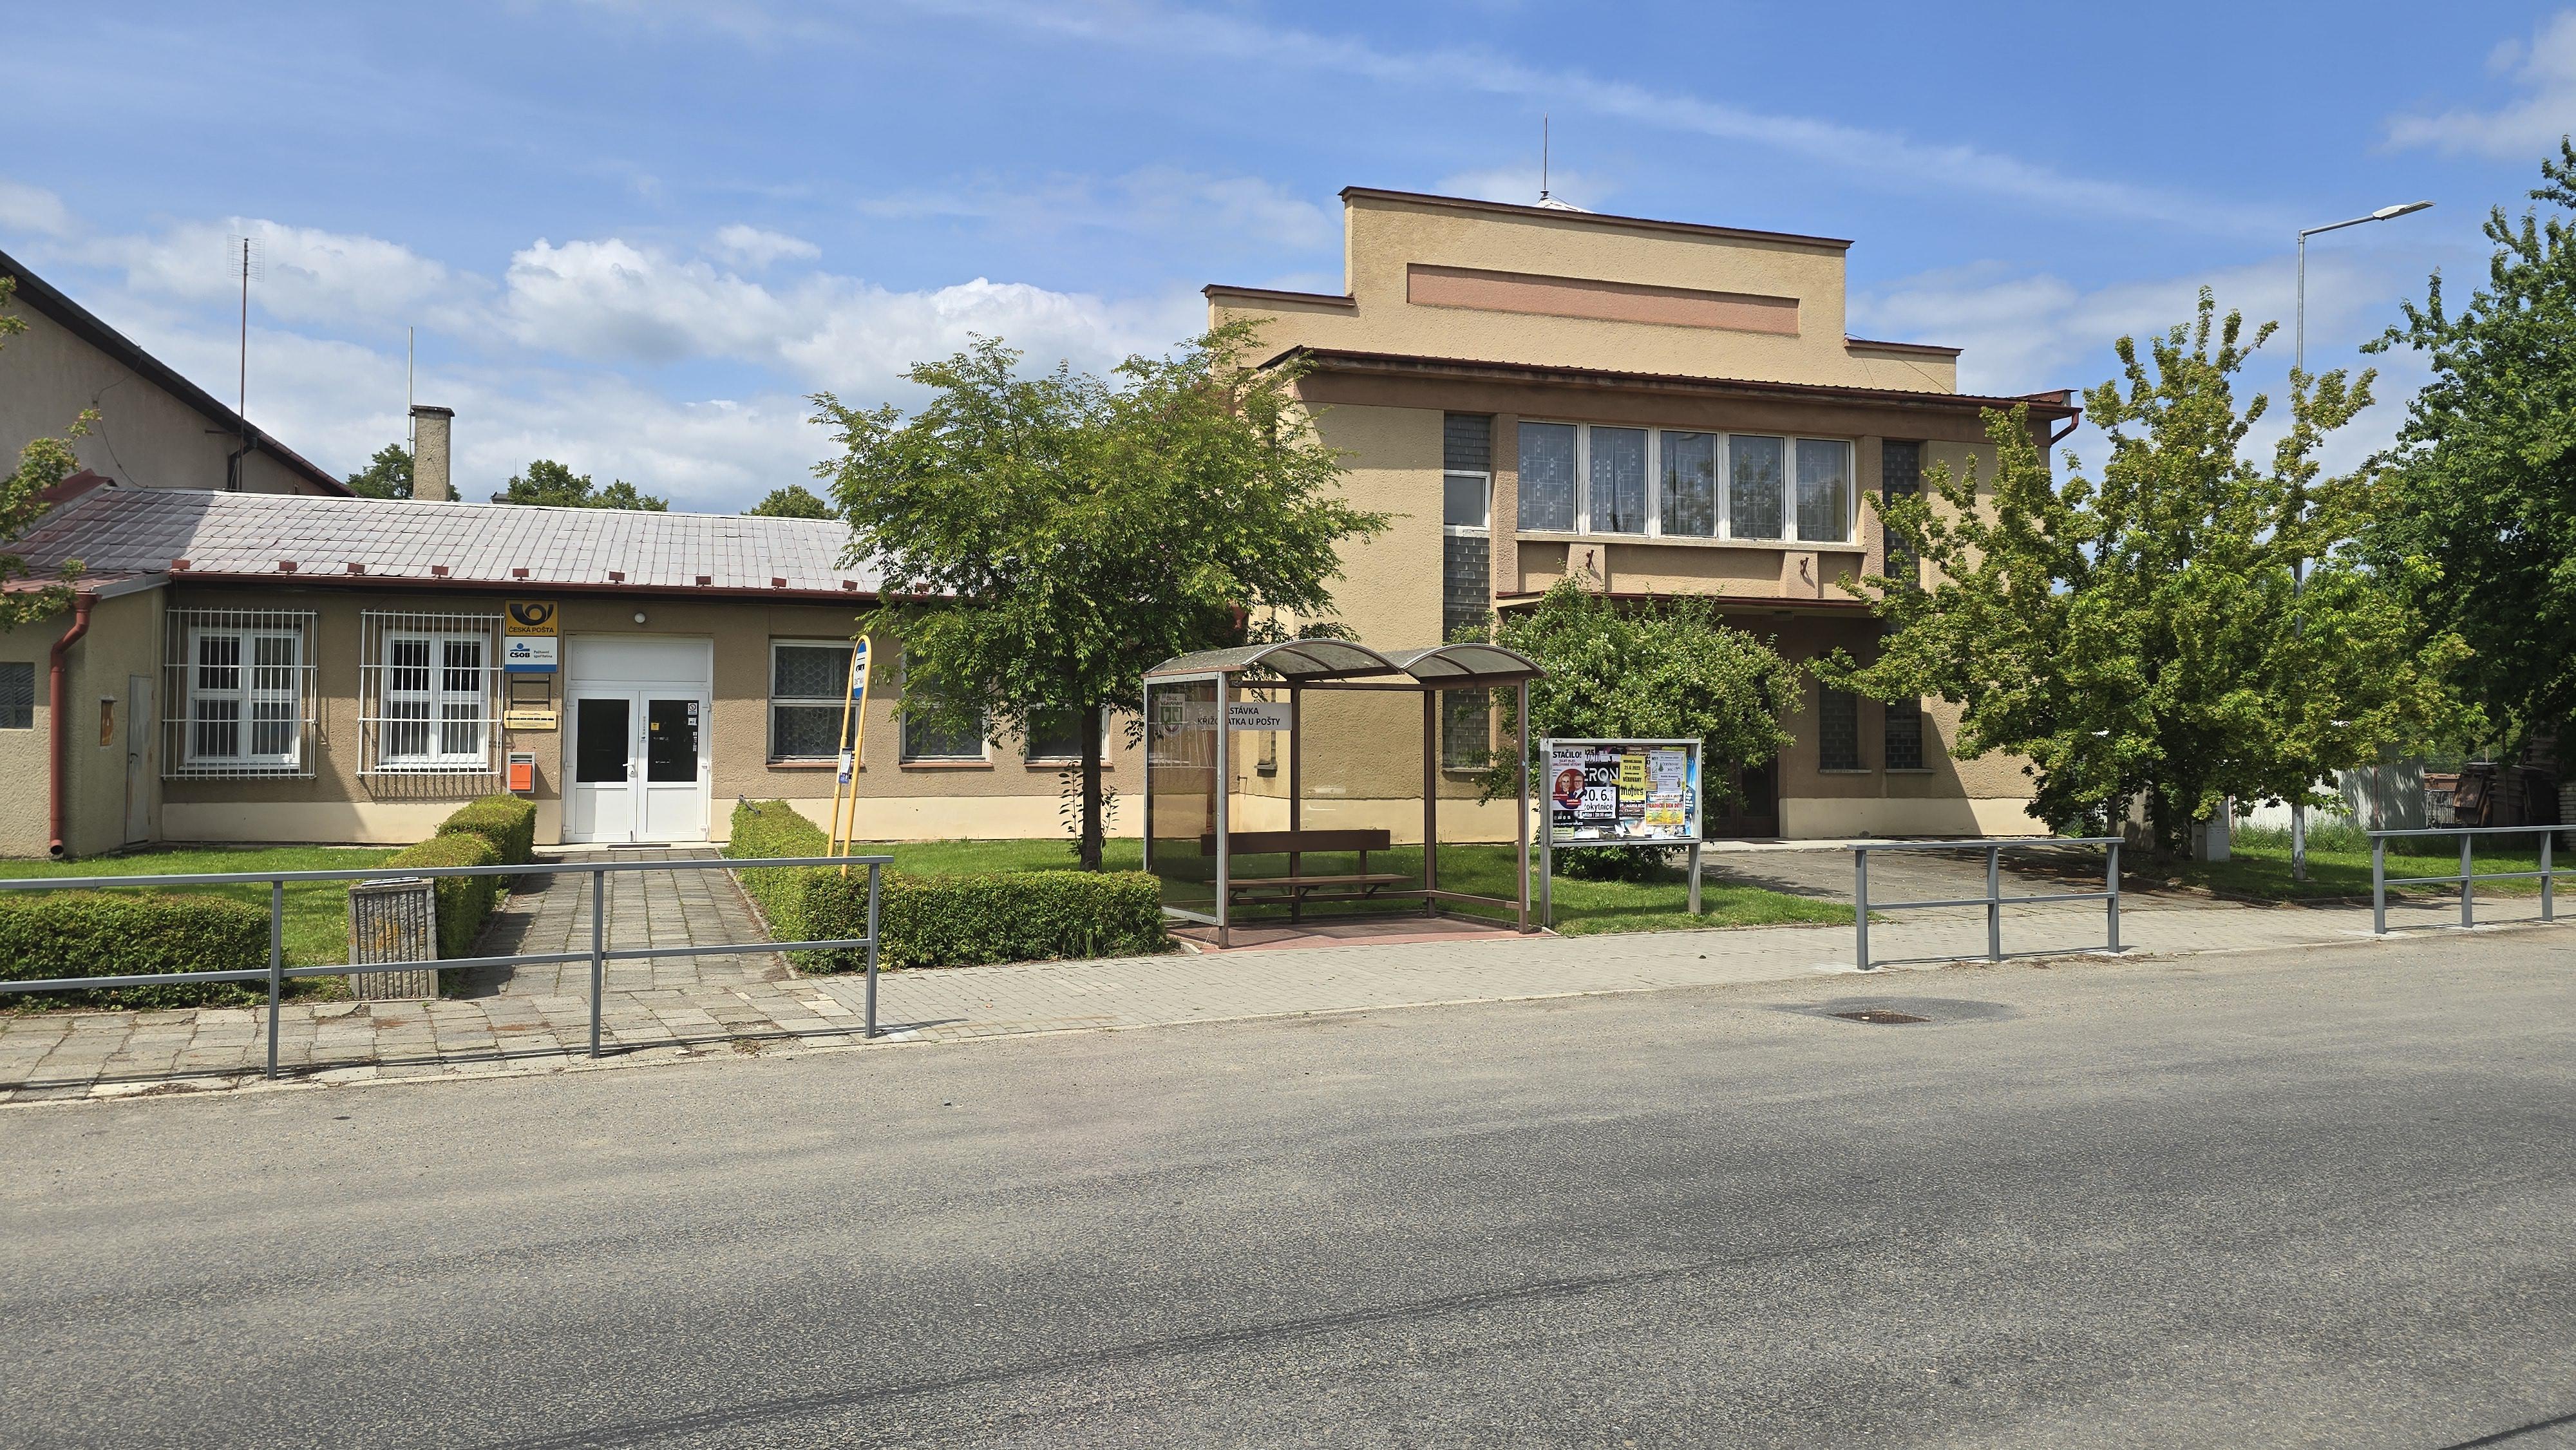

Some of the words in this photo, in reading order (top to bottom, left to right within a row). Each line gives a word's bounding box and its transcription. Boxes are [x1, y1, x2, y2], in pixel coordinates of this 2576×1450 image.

[1229, 706, 1259, 715] STÁVKA
[1256, 716, 1280, 726] POŠTY
[1553, 749, 1582, 758] STAČILO!
[1600, 789, 1609, 801] 6.
